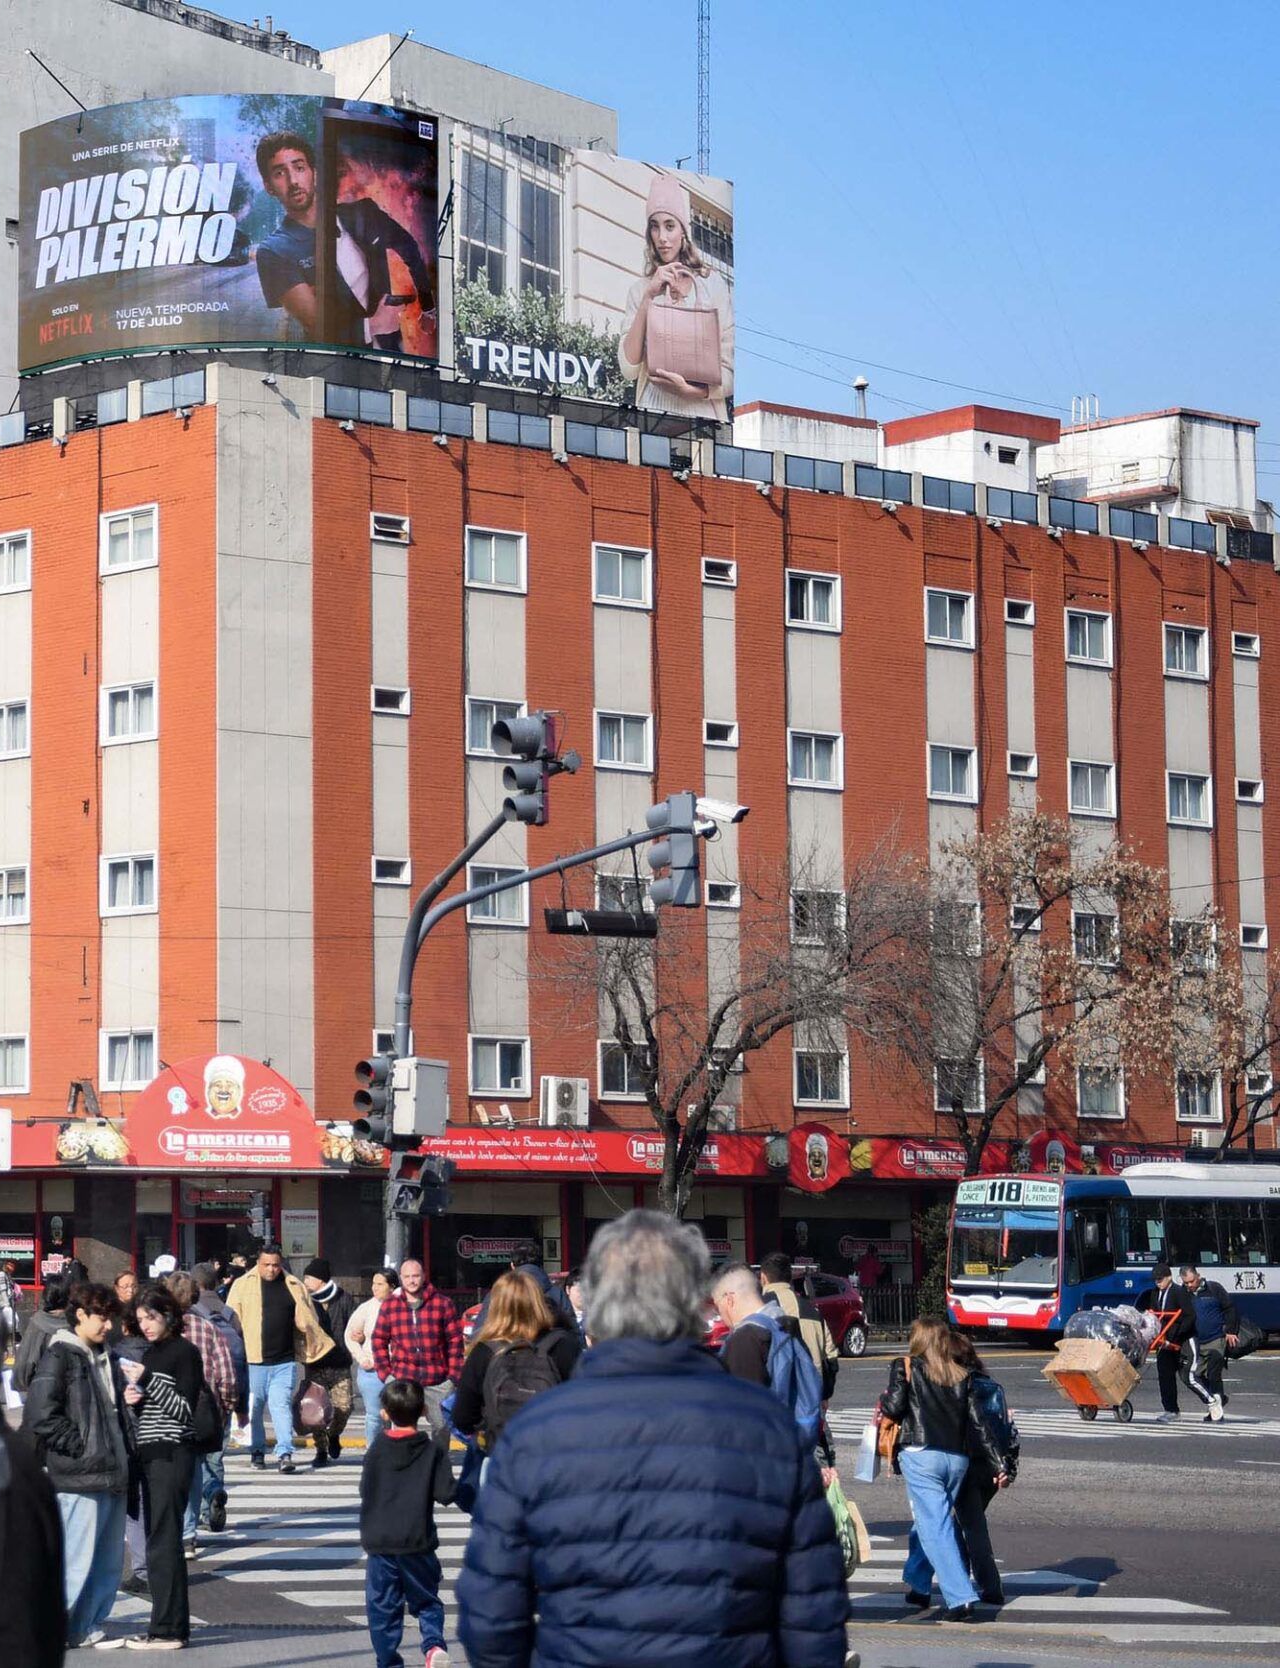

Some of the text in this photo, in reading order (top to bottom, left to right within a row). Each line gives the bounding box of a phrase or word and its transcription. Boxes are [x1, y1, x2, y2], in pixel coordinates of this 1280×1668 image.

[72, 137, 180, 162] UNA SERIE DE NETFLIX
[35, 155, 238, 240] DIVISIÓN
[35, 213, 237, 289] PALERMO
[51, 303, 80, 317] SOLO EN
[115, 301, 230, 319] NUEVA TEMPORADA
[39, 313, 94, 345] NETFLIX
[116, 315, 183, 330] 17 DE JULIO
[464, 337, 602, 389] TRENDY
[962, 1193, 978, 1201] ONCE
[989, 1181, 1022, 1202] 118
